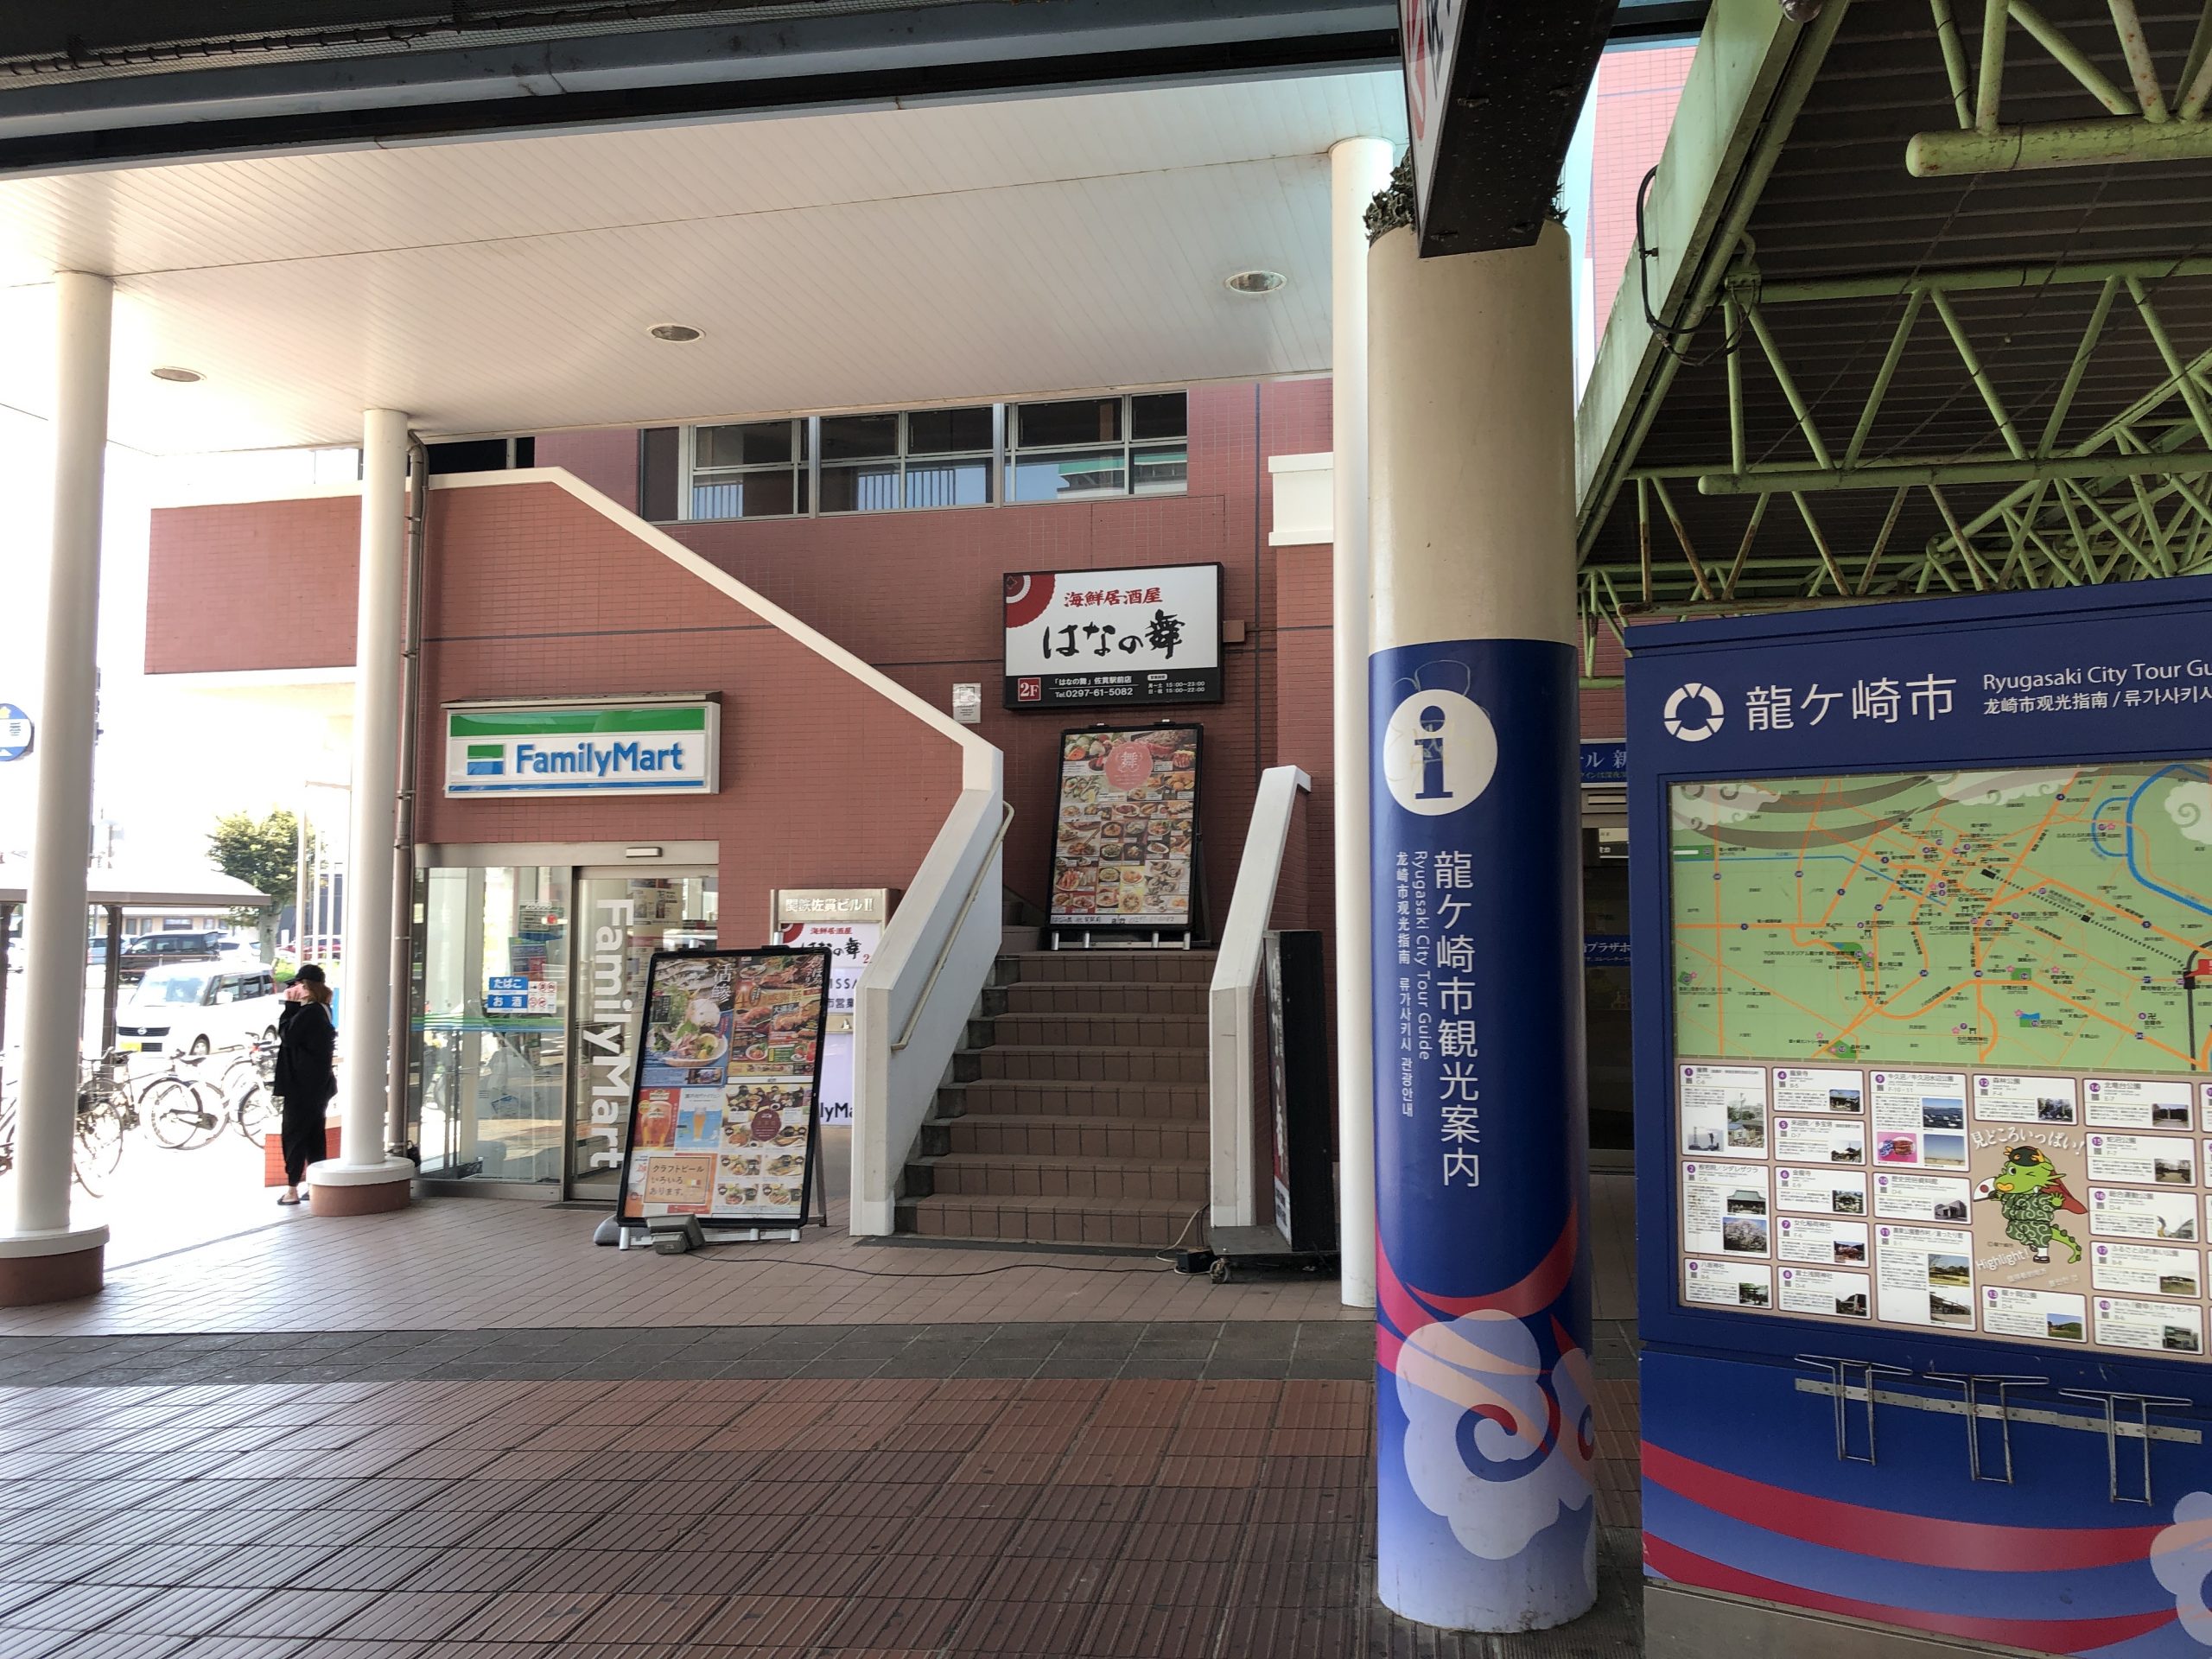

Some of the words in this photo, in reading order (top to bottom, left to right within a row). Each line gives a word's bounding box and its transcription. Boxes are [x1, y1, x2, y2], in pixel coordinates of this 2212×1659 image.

[1064, 587, 1163, 607] 海鮮居酒屋
[1042, 608, 1185, 659] はなの舞
[1020, 681, 1040, 697] 2F
[1983, 668, 2082, 694] Ryugasaki
[2088, 666, 2128, 686] City
[2131, 663, 2183, 681] Tour
[516, 741, 685, 778] FamilyMart
[1580, 751, 1605, 769] ル
[1412, 850, 1430, 928] Ryugasaki
[1414, 934, 1431, 967] City
[493, 977, 522, 989] たばこ
[1417, 970, 1432, 1008] Tour
[583, 899, 635, 1168] FamilyMart
[1416, 1012, 1433, 1061] Guide
